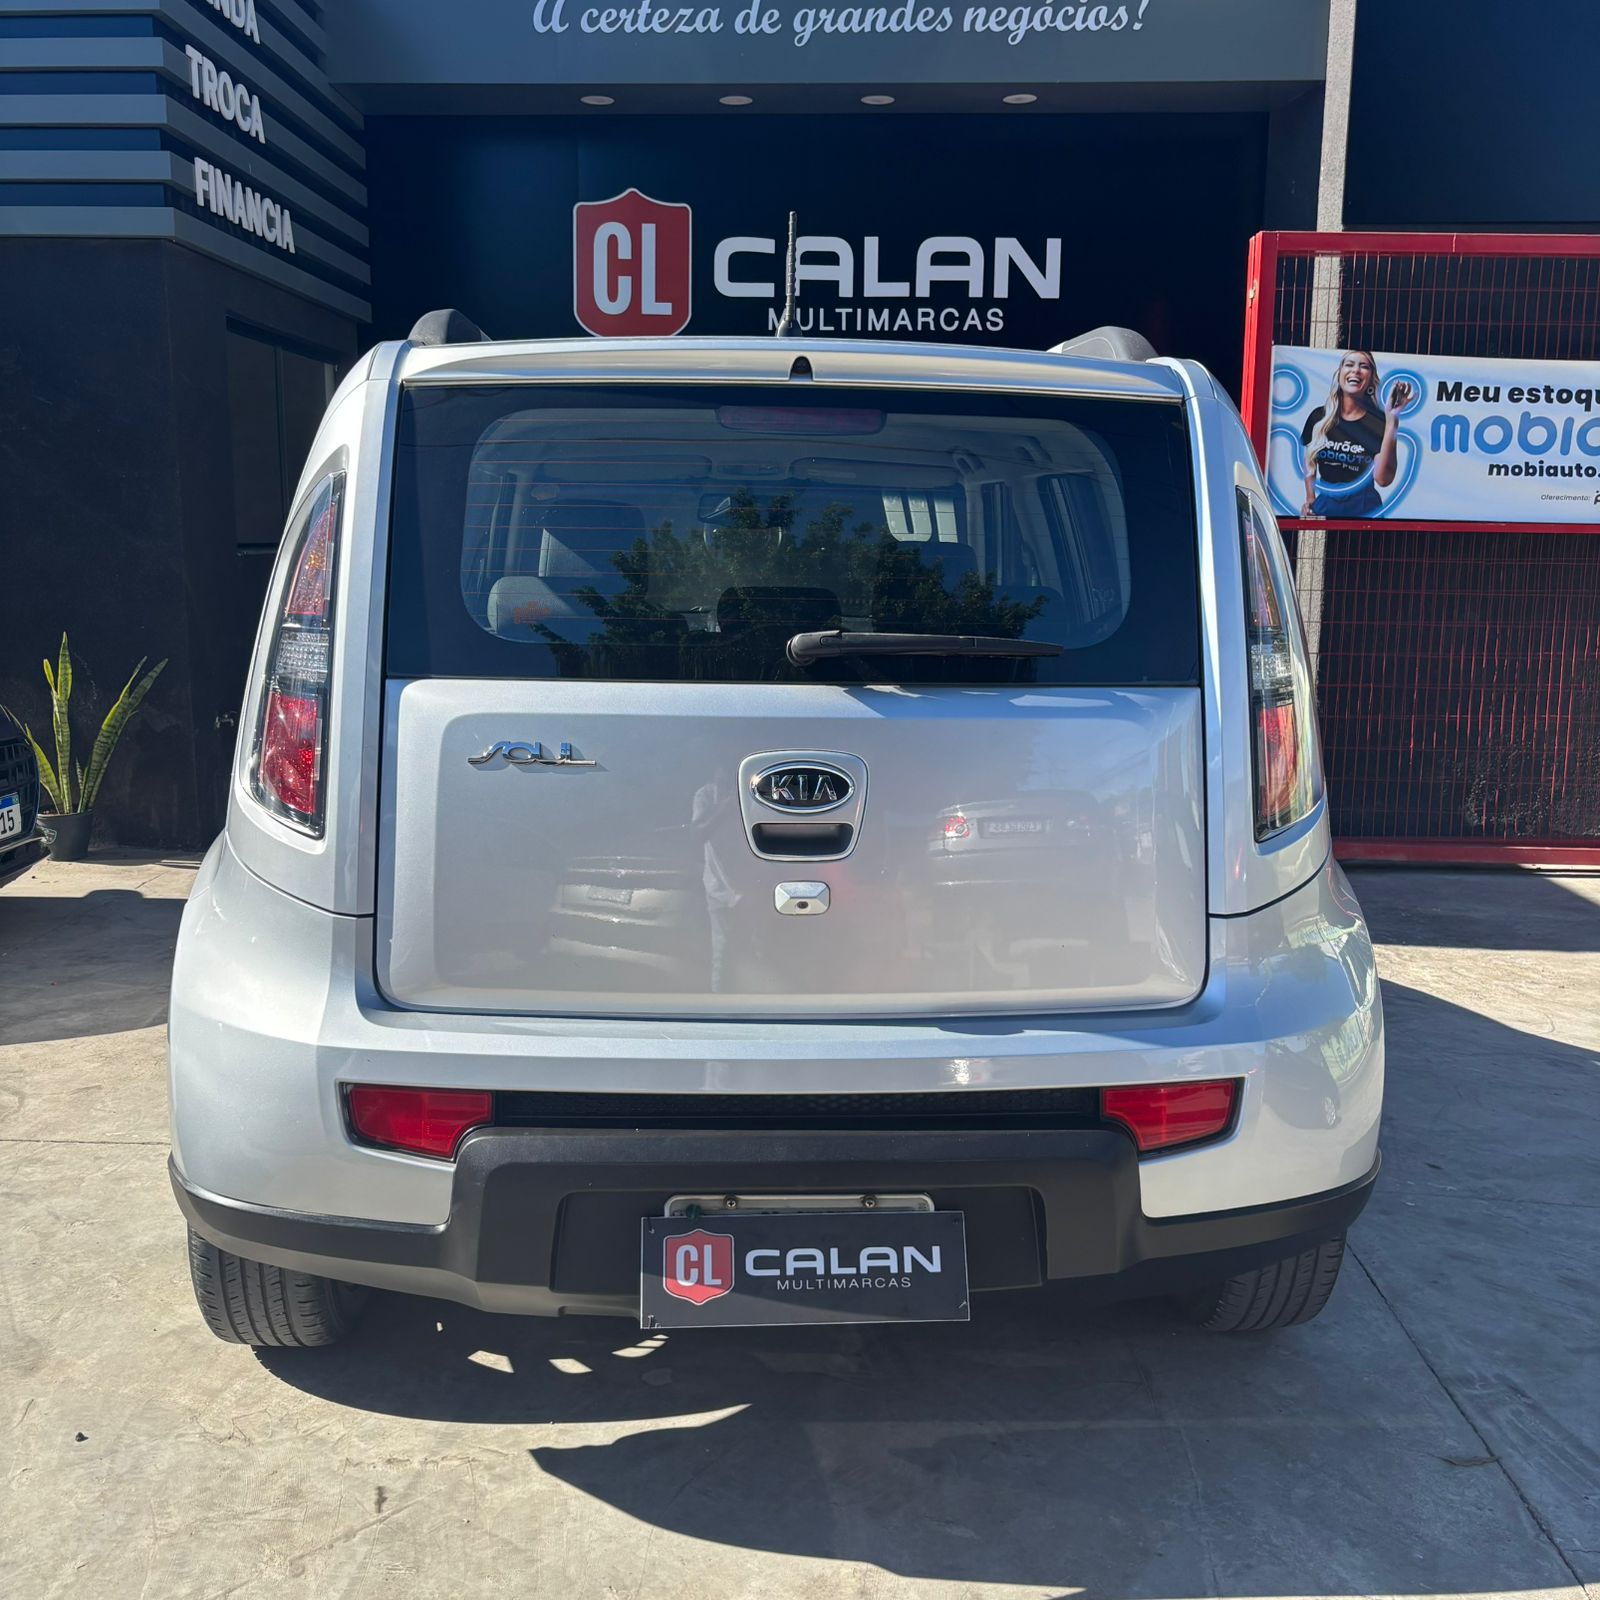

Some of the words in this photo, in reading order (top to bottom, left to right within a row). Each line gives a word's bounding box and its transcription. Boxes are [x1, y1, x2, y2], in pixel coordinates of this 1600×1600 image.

[580, 0, 724, 33] certeza
[734, 0, 782, 34] de
[793, 0, 953, 47] grandes
[185, 44, 266, 144] TROCA
[193, 156, 296, 254] FINANCIA
[593, 222, 672, 316] CL
[713, 236, 1062, 299] CALAN
[768, 307, 1004, 333] MULTIMARCAS
[1437, 381, 1501, 402] Meu
[770, 775, 838, 800] KIA
[675, 1244, 722, 1286] CL
[745, 1246, 941, 1276] CALAN
[777, 1277, 912, 1291] MULTIMARCAS
